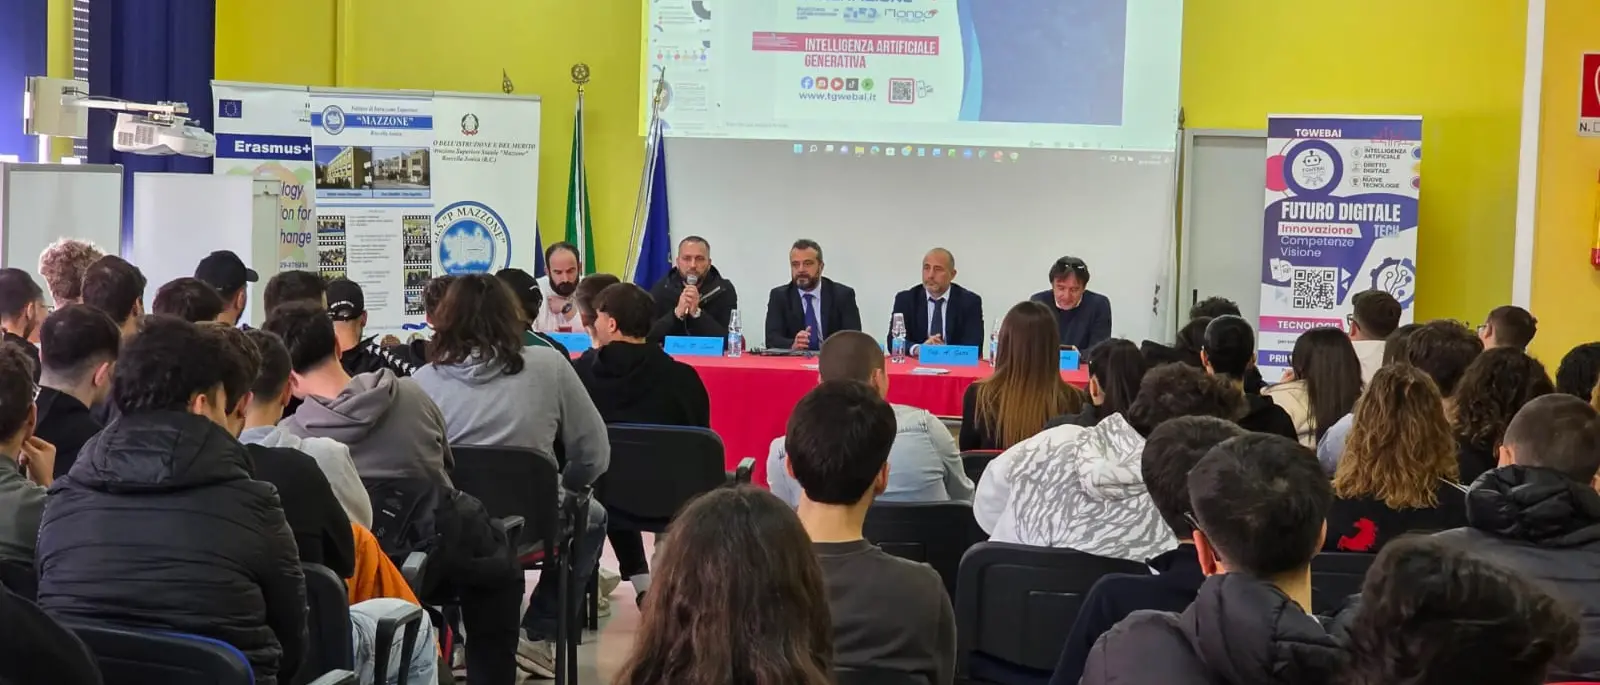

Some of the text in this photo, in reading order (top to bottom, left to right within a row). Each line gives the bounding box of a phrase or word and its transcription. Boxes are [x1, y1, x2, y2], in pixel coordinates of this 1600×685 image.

[804, 37, 936, 54] INTELLIGENZA ARTIFICIALE
[804, 54, 867, 68] GENERATIVA
[1294, 128, 1342, 138] TGWEBAI
[234, 140, 311, 154] Erasmus+
[298, 205, 312, 220] for
[1281, 201, 1401, 222] FUTURO DIGITALE
[1281, 224, 1353, 235] Innovazione
[1373, 224, 1400, 238] TECH
[1280, 235, 1355, 247] Competenze
[1280, 247, 1322, 257] Visione
